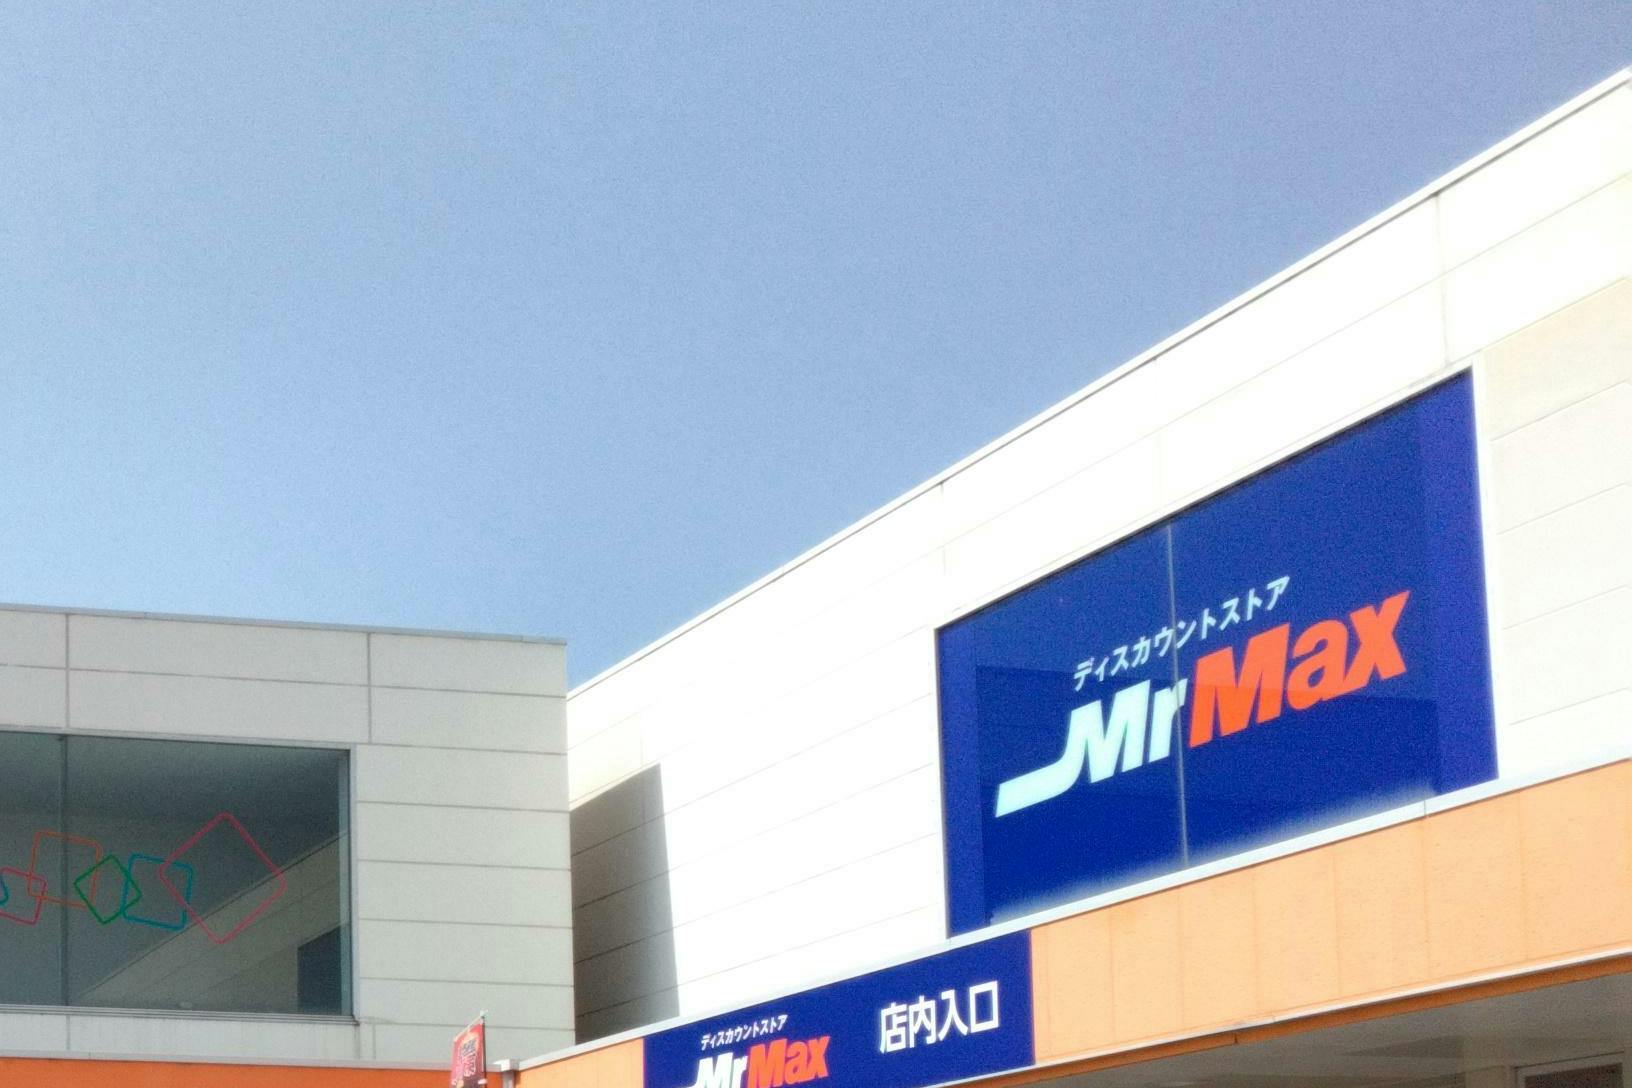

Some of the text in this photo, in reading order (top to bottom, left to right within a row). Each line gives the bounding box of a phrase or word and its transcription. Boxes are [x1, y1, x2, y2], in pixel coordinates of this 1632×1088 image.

[1072, 575, 1290, 693] ディスカウントストア
[994, 590, 1411, 819] MrMax
[700, 1013, 789, 1053] ディスカウントストア
[879, 980, 1000, 1055] 店内入口
